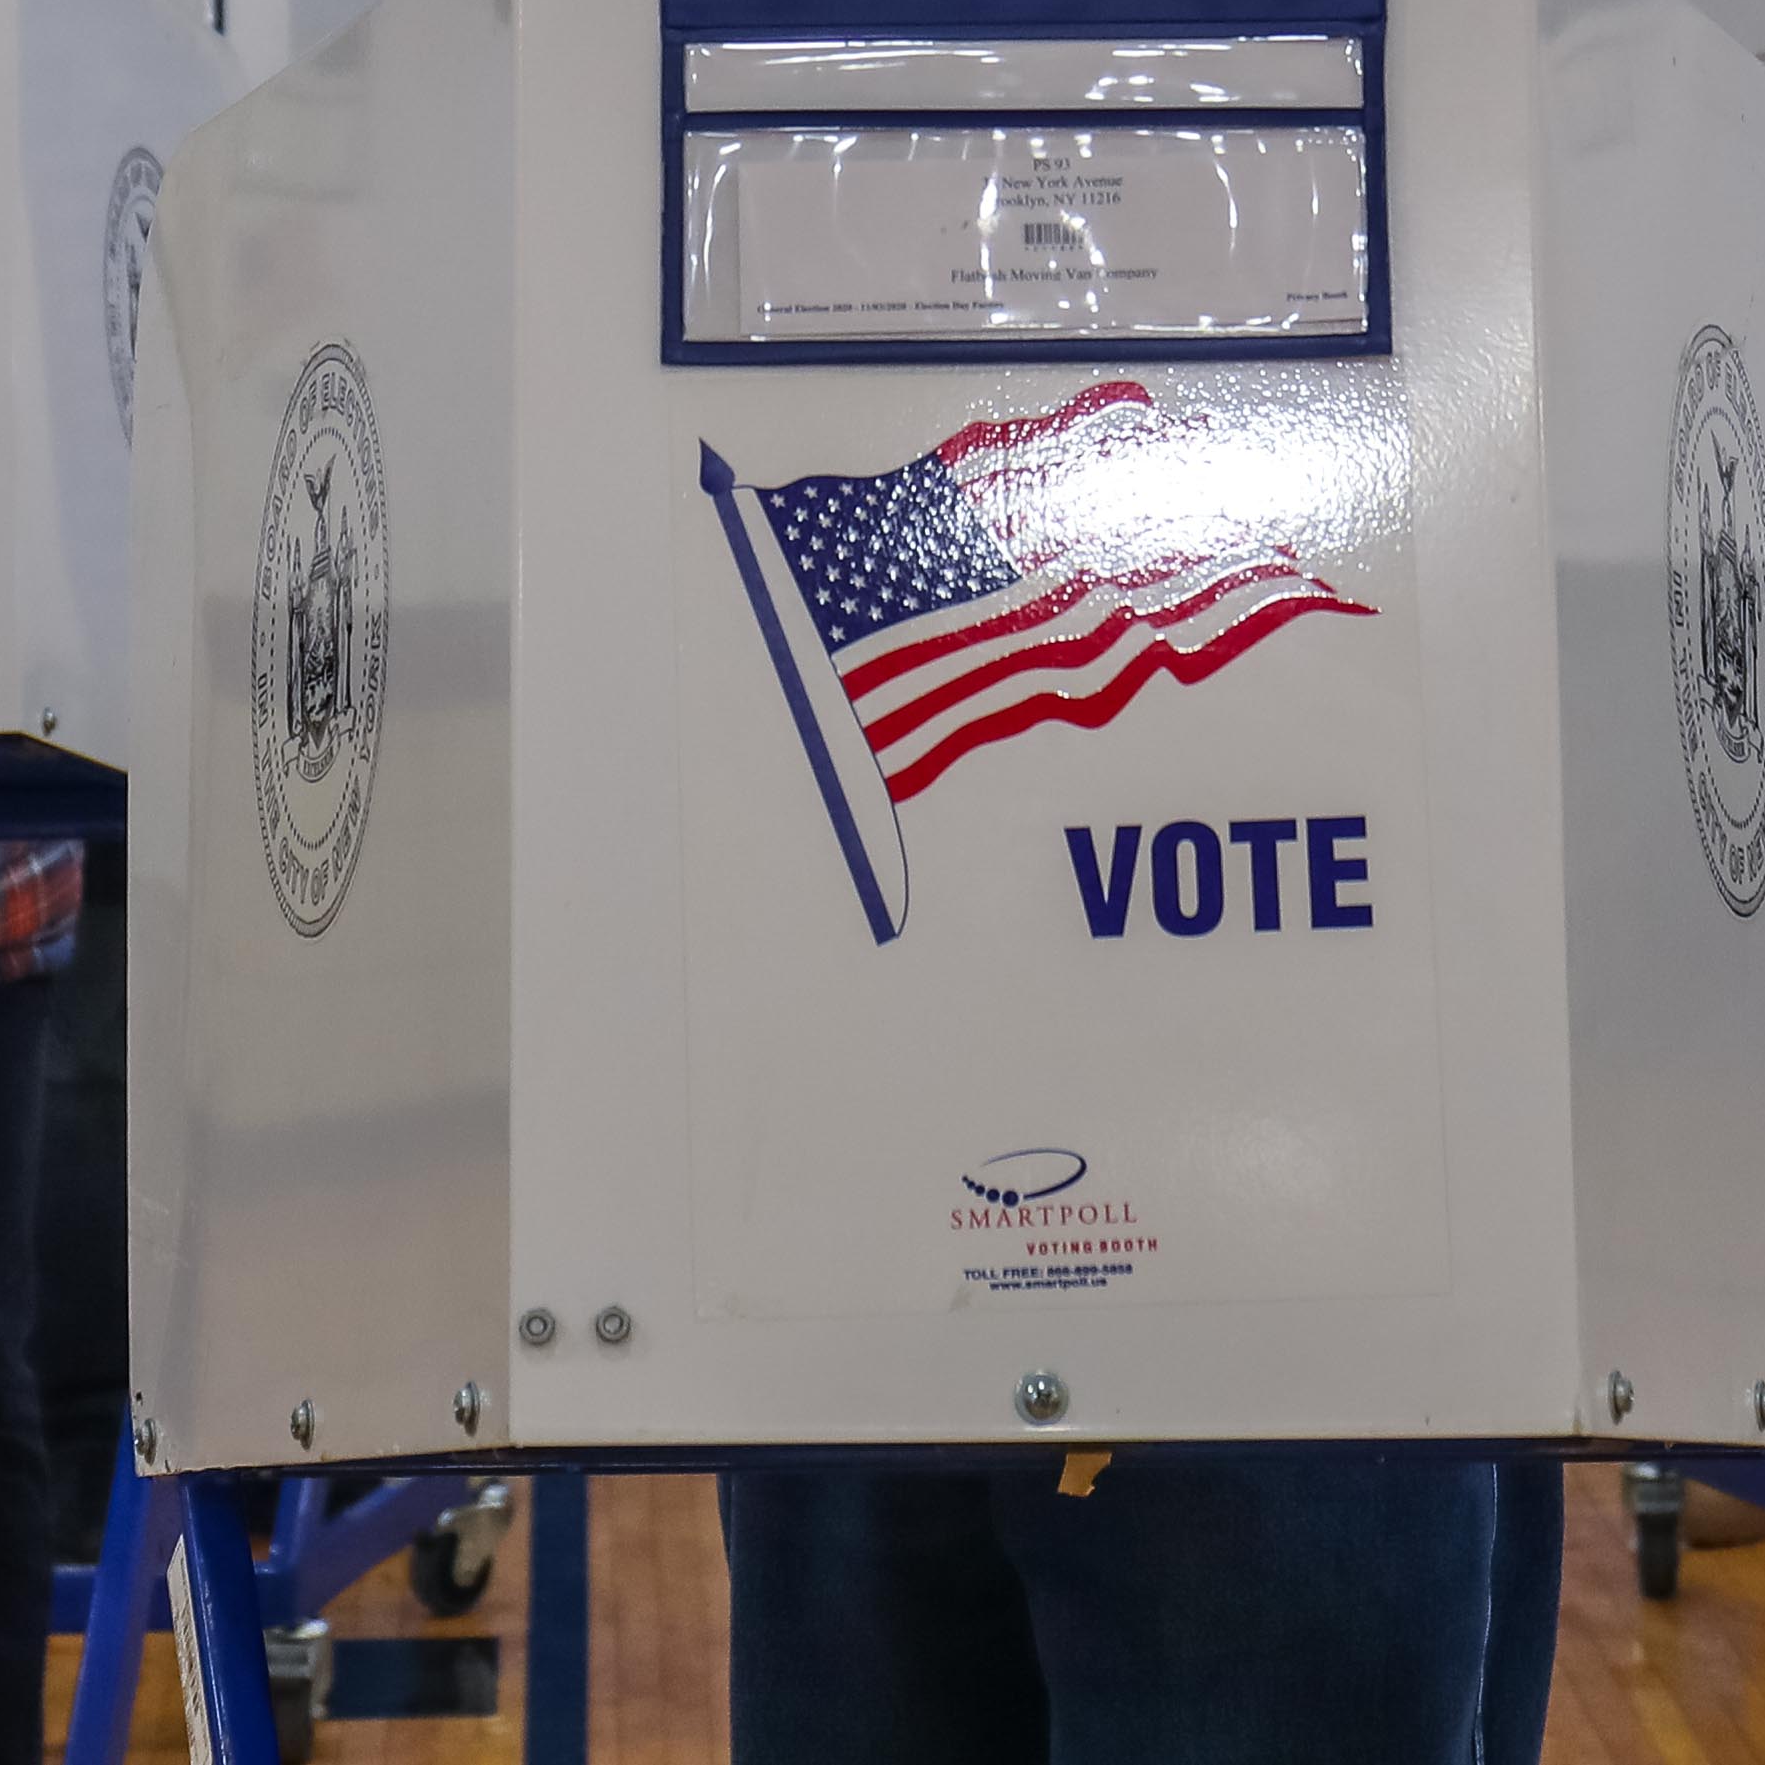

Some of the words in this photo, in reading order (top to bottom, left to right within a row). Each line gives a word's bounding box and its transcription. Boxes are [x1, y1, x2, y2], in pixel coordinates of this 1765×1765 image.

[1033, 158, 1051, 172] PS
[1054, 158, 1071, 171] 93
[1002, 177, 1033, 189] New
[1037, 176, 1069, 189] York
[1073, 176, 1124, 188] Avenue
[1053, 193, 1077, 206] NY
[1081, 192, 1123, 206] 11216
[1011, 268, 1062, 283] Moving
[1065, 267, 1093, 280] Van
[1706, 350, 1722, 390] OF
[261, 428, 298, 602] BOARD
[299, 379, 318, 435] OF
[321, 371, 380, 541] ELECTIONS
[258, 672, 269, 729] IN
[279, 836, 309, 905] CITY
[310, 858, 330, 907] OF
[359, 612, 382, 762] YORK
[1729, 842, 1744, 885] OF
[1064, 816, 1373, 939] VOTE
[950, 1202, 1138, 1231] SMARTPOLL
[1026, 1240, 1093, 1257] VOTING
[1099, 1238, 1159, 1253] BOOTH
[963, 1268, 998, 1281] TOLL
[1002, 1266, 1044, 1280] FREE:
